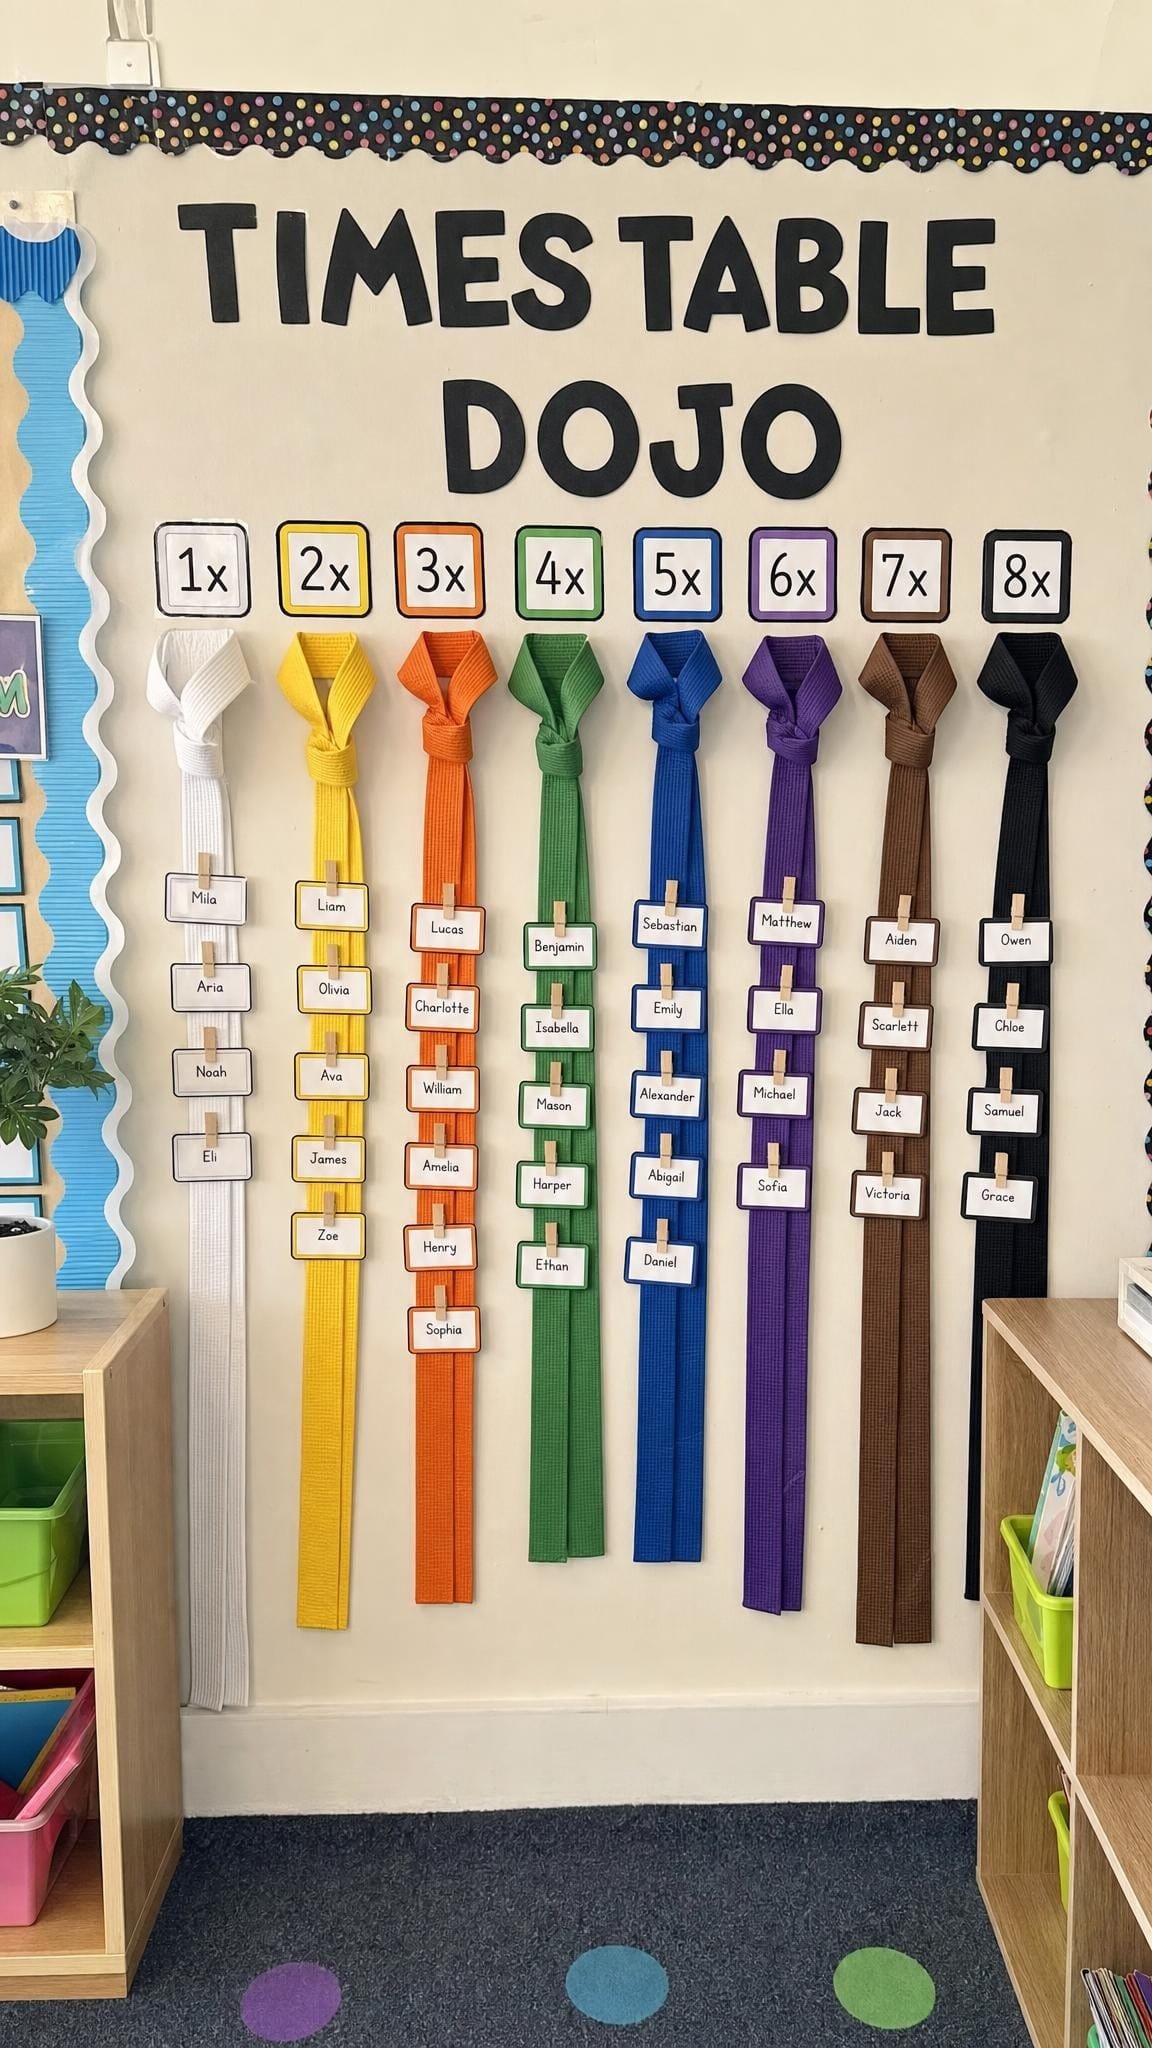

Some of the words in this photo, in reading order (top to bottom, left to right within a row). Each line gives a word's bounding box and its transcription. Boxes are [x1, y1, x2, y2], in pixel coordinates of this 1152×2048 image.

[178, 203, 594, 332] TIMES
[617, 215, 996, 336] TABLE
[443, 379, 842, 500] DOJO
[178, 547, 228, 593] 1x
[300, 545, 350, 592] 2x
[416, 547, 466, 593] 3x
[535, 550, 585, 595] 4x
[654, 552, 701, 596] 5x
[770, 552, 816, 597] 6x
[882, 553, 928, 597] 7x
[1003, 553, 1051, 599] 8x
[191, 891, 217, 905] Mila
[318, 898, 346, 912] Liam
[431, 920, 464, 935] Lucas
[643, 916, 697, 932] Sebastian
[761, 913, 812, 929] Matthew
[885, 933, 917, 946] Aiden
[1001, 933, 1032, 946] Owen
[534, 939, 585, 957] Benjamin
[196, 979, 224, 993] Aria
[318, 982, 350, 995] Olivia
[415, 999, 469, 1014] Charlotte
[653, 1001, 683, 1019] Emily
[774, 1002, 794, 1016] Ella
[535, 1020, 579, 1034] Isabella
[872, 1018, 919, 1033] Scarlett
[994, 1019, 1025, 1033] Chloe
[196, 1065, 227, 1078] Noah
[320, 1069, 343, 1082] Ava
[423, 1081, 462, 1095] William
[639, 1087, 695, 1102] Alexander
[753, 1086, 796, 1100] Michael
[536, 1097, 572, 1111] Mason
[875, 1104, 902, 1118] Jack
[984, 1103, 1024, 1117] Samuel
[202, 1149, 217, 1163] Eli
[309, 1151, 347, 1165] James
[422, 1159, 460, 1173] Amelia
[647, 1168, 685, 1187] Abigail
[533, 1177, 572, 1194] Harper
[758, 1179, 788, 1192] Sofia
[865, 1186, 910, 1201] Victoria
[981, 1188, 1015, 1203] Grace
[317, 1228, 339, 1241] Zoe
[423, 1240, 457, 1257] Henry
[535, 1258, 569, 1272] Ethan
[644, 1253, 677, 1268] Daniel
[426, 1322, 462, 1339] Sophia
